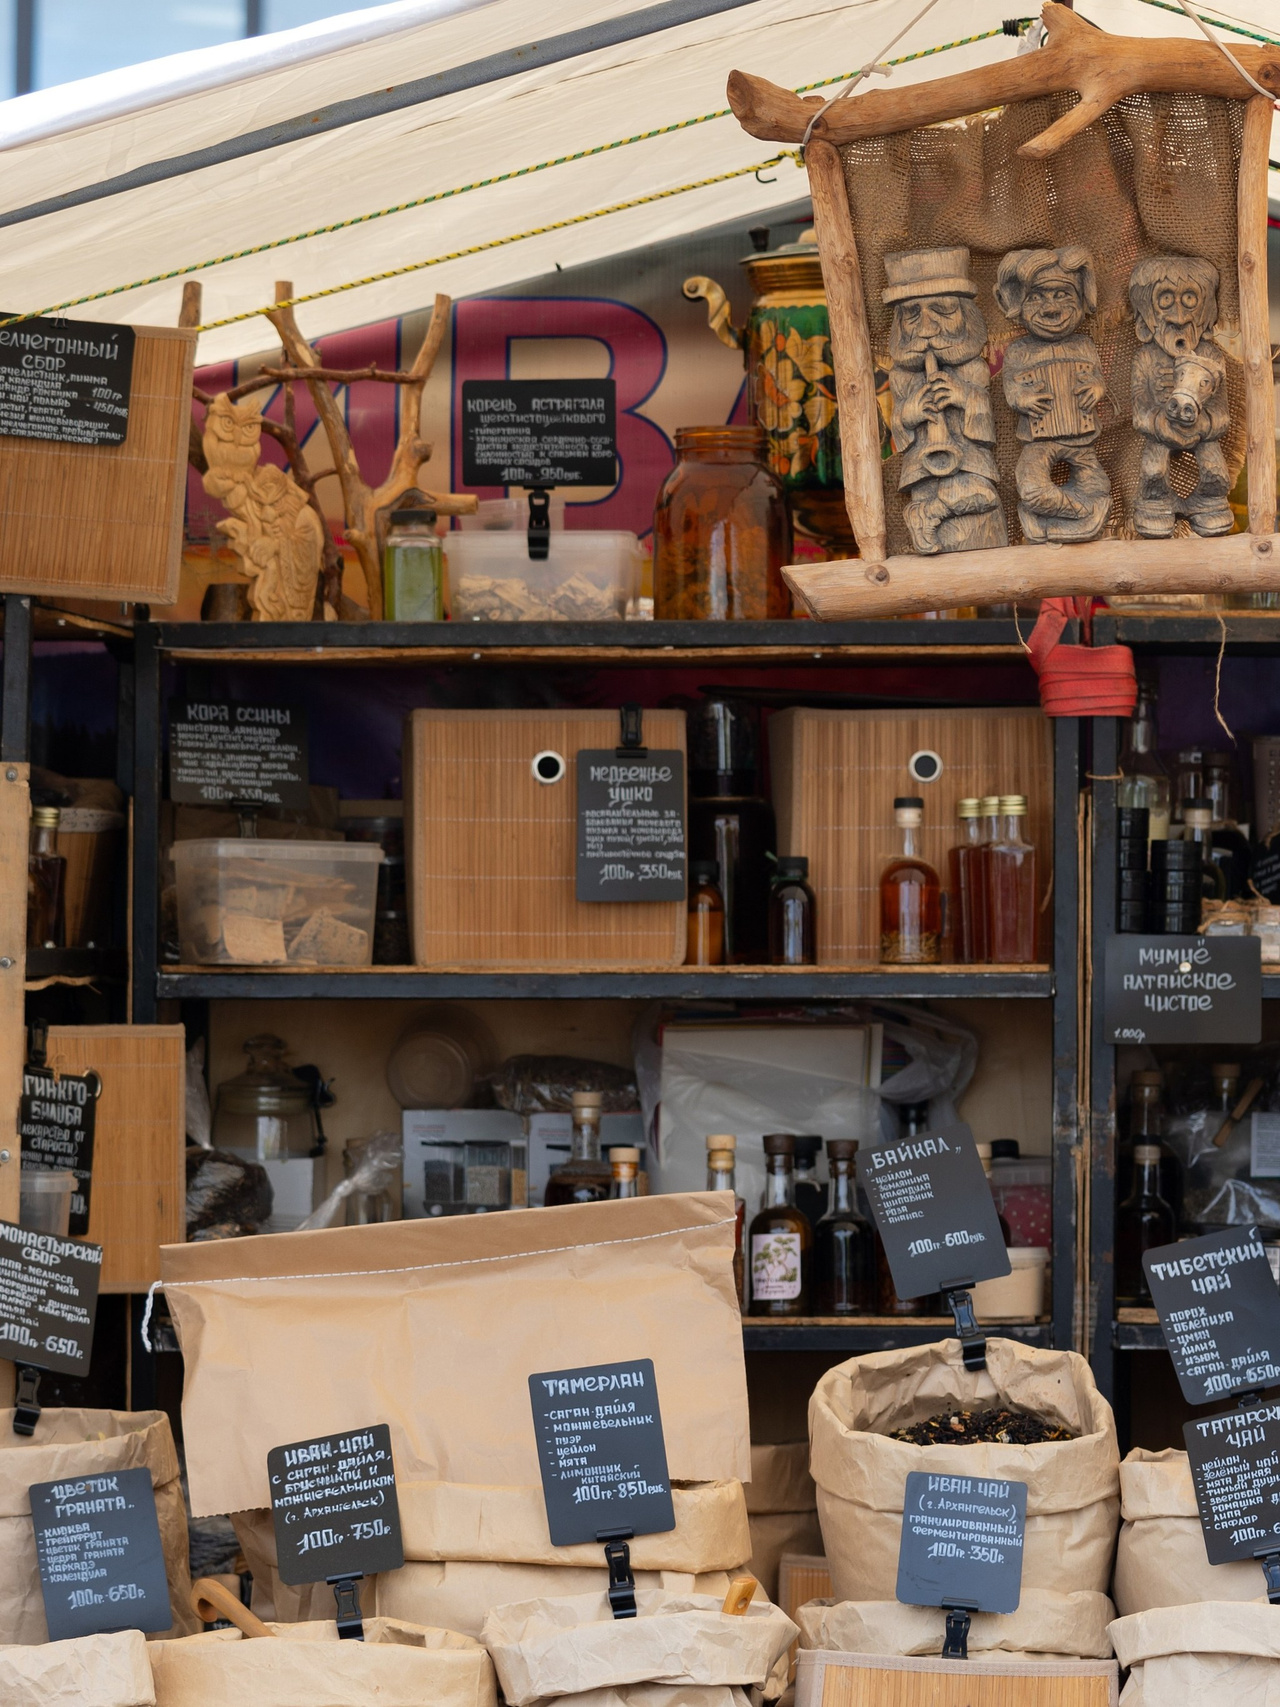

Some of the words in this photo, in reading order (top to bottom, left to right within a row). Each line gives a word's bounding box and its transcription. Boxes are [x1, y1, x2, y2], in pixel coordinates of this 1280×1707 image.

[22, 354, 66, 371] СБОР
[467, 399, 517, 412] КОРЕНЬ
[531, 398, 605, 412] АСТРАГАЛА
[187, 704, 229, 721] КОРА
[236, 708, 291, 725] ОСИНЫ
[608, 786, 653, 808] УШКО
[1139, 938, 1211, 967] МУМИЁ
[1124, 969, 1236, 990] АЛТАЙСКОЕ
[1144, 994, 1213, 1012] ЧИСТОЕ
[879, 1173, 930, 1192] ЗЕМЛЯНИКА
[880, 1183, 932, 1200] КАЛЕНДУЛА
[883, 1191, 934, 1211] ШИПОВНИК
[885, 1206, 908, 1217] РОЗА
[888, 1210, 925, 1224] АНАНАС
[0, 1223, 103, 1265] МОНАСТЫРСКИЙ
[22, 1246, 61, 1267] СБОР
[1150, 1227, 1265, 1281] ТИБЕТСКИЙ
[1191, 1268, 1231, 1295] ЧАЙ
[1173, 1311, 1234, 1333] ОБЛЕПИХА
[1181, 1339, 1217, 1356] ЛИЛИЯ
[1185, 1352, 1220, 1366] ИЗЮМ
[542, 1371, 645, 1397] ТАМЕРЛАН
[553, 1414, 654, 1433] МОЖЖЕВЕЛЬНИК
[555, 1435, 582, 1445] ПУЭР
[1225, 1424, 1266, 1448] ЧАЙ
[556, 1444, 596, 1459] ЦЕЙЛОН
[559, 1457, 588, 1468] МЯТА
[1202, 1455, 1240, 1473] ЦЕЙЛОН
[1204, 1459, 1250, 1481] ЗЕЛЁНЫЙ
[1256, 1450, 1279, 1468] ЧАЙ
[285, 1467, 362, 1494] БРУСНИКОЙ
[560, 1464, 621, 1480] ЛИМОННИК
[581, 1465, 641, 1485] КИТАЙСКИЙ
[1206, 1476, 1232, 1489] МЯТА
[1237, 1467, 1272, 1484] ДИКАЯ
[1206, 1481, 1248, 1497] ТИМЬЯН
[1210, 1487, 1261, 1505] ЗВЕРОБОЙ
[1212, 1496, 1263, 1513] РОМАШКА
[1213, 1510, 1241, 1522] ЛИПА
[1214, 1515, 1258, 1530] САФЛОР
[44, 1522, 90, 1538] КЛЮКВА
[46, 1531, 104, 1547] ГРЕЙПФРУТ
[46, 1544, 81, 1557] ЦВЕТОК
[85, 1536, 130, 1550] ГРАНАТА
[47, 1554, 77, 1567] ЦЕДРА
[84, 1548, 125, 1559] ГРАНАТА
[48, 1561, 96, 1573] КАРКАДЭ
[50, 1568, 107, 1583] КАЛЕНДУЛА
